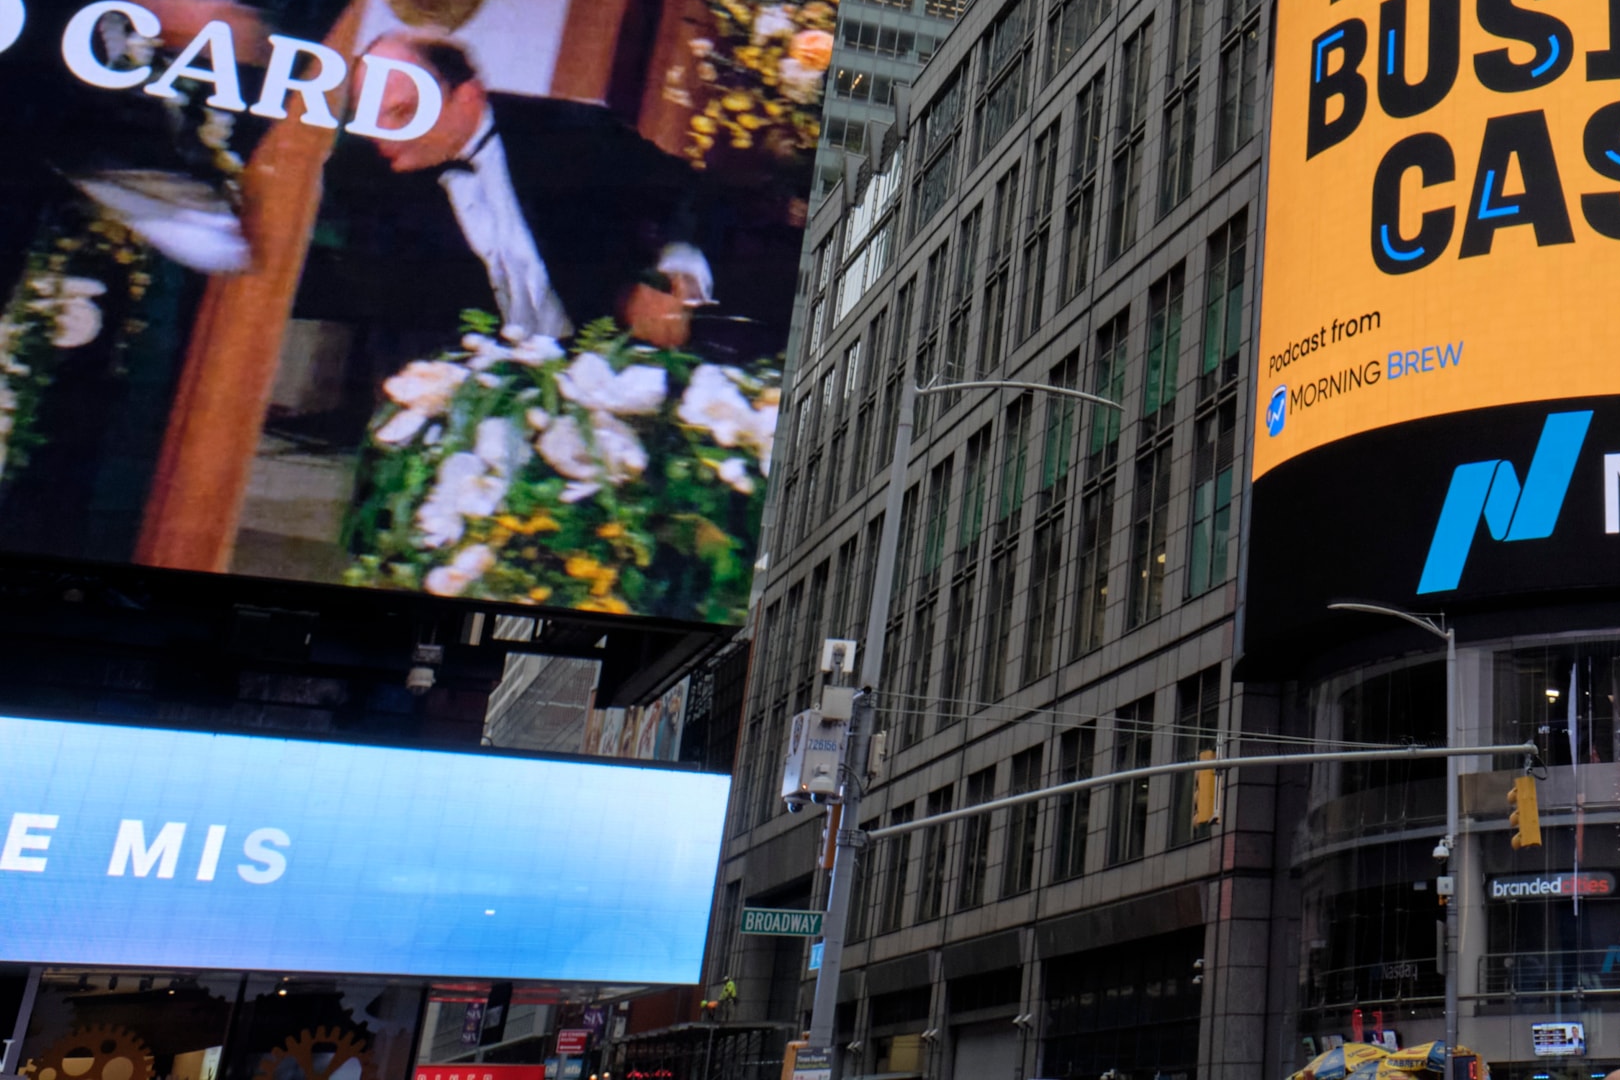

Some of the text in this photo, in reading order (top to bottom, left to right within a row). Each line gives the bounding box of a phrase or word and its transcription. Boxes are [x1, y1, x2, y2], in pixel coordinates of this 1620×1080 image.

[62, 0, 442, 142] CARD
[1269, 311, 1381, 378] Podcast from
[1290, 341, 1464, 415] MORNING BREW
[107, 819, 291, 885] MIS
[745, 912, 819, 933] BROADWAY
